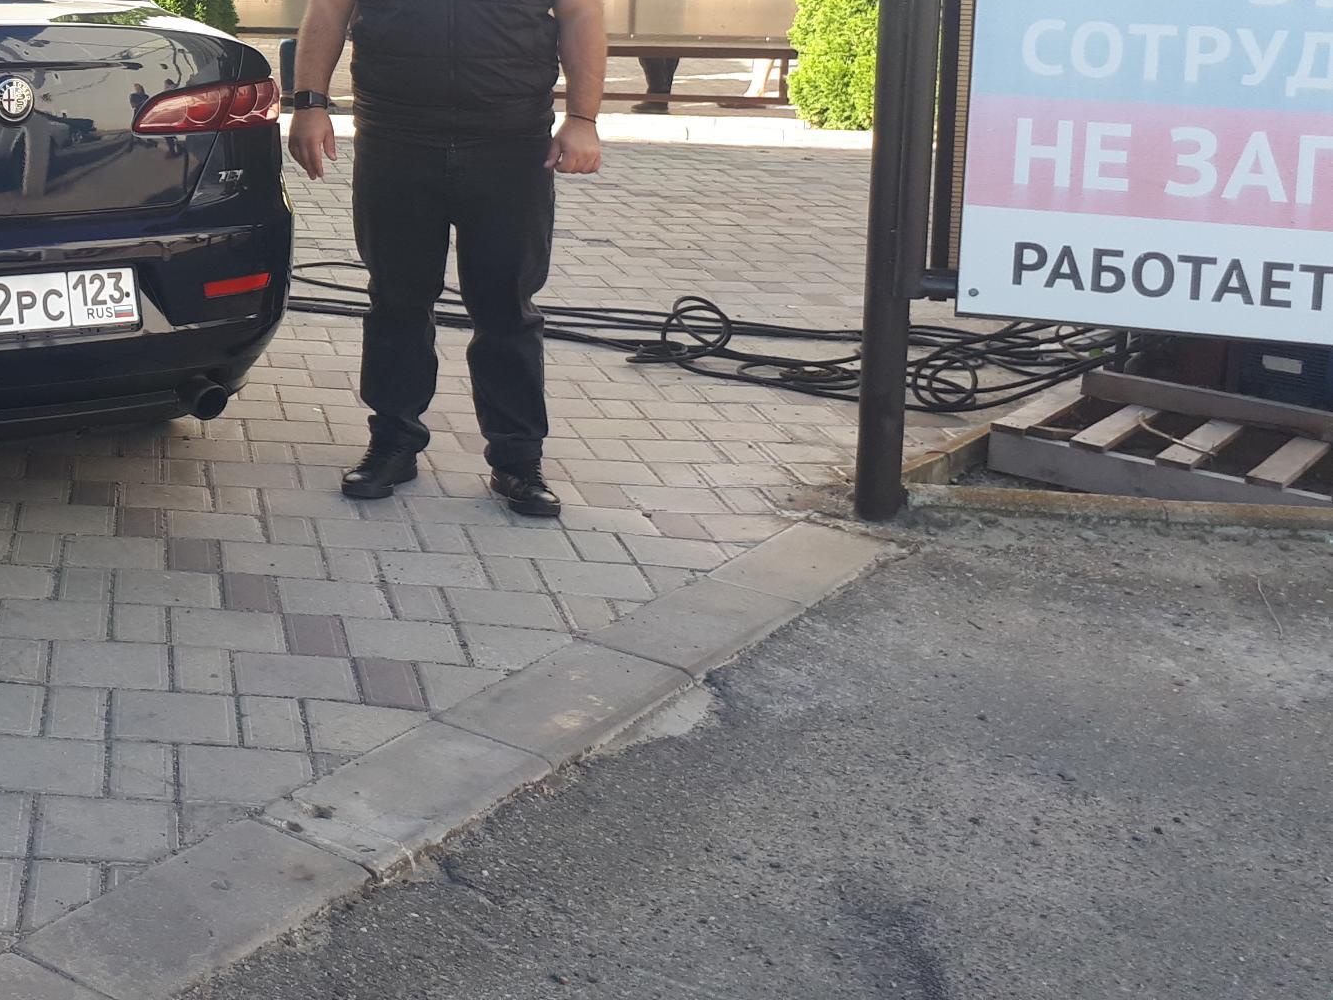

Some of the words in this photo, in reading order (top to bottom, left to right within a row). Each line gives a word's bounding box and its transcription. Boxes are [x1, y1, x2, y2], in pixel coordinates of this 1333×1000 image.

[1021, 18, 1333, 97] СОТРУД
[1012, 117, 1132, 192] НЕ
[72, 271, 125, 307] 123
[1012, 241, 1333, 312] РАБОТАЕТ
[86, 307, 113, 320] RUS
